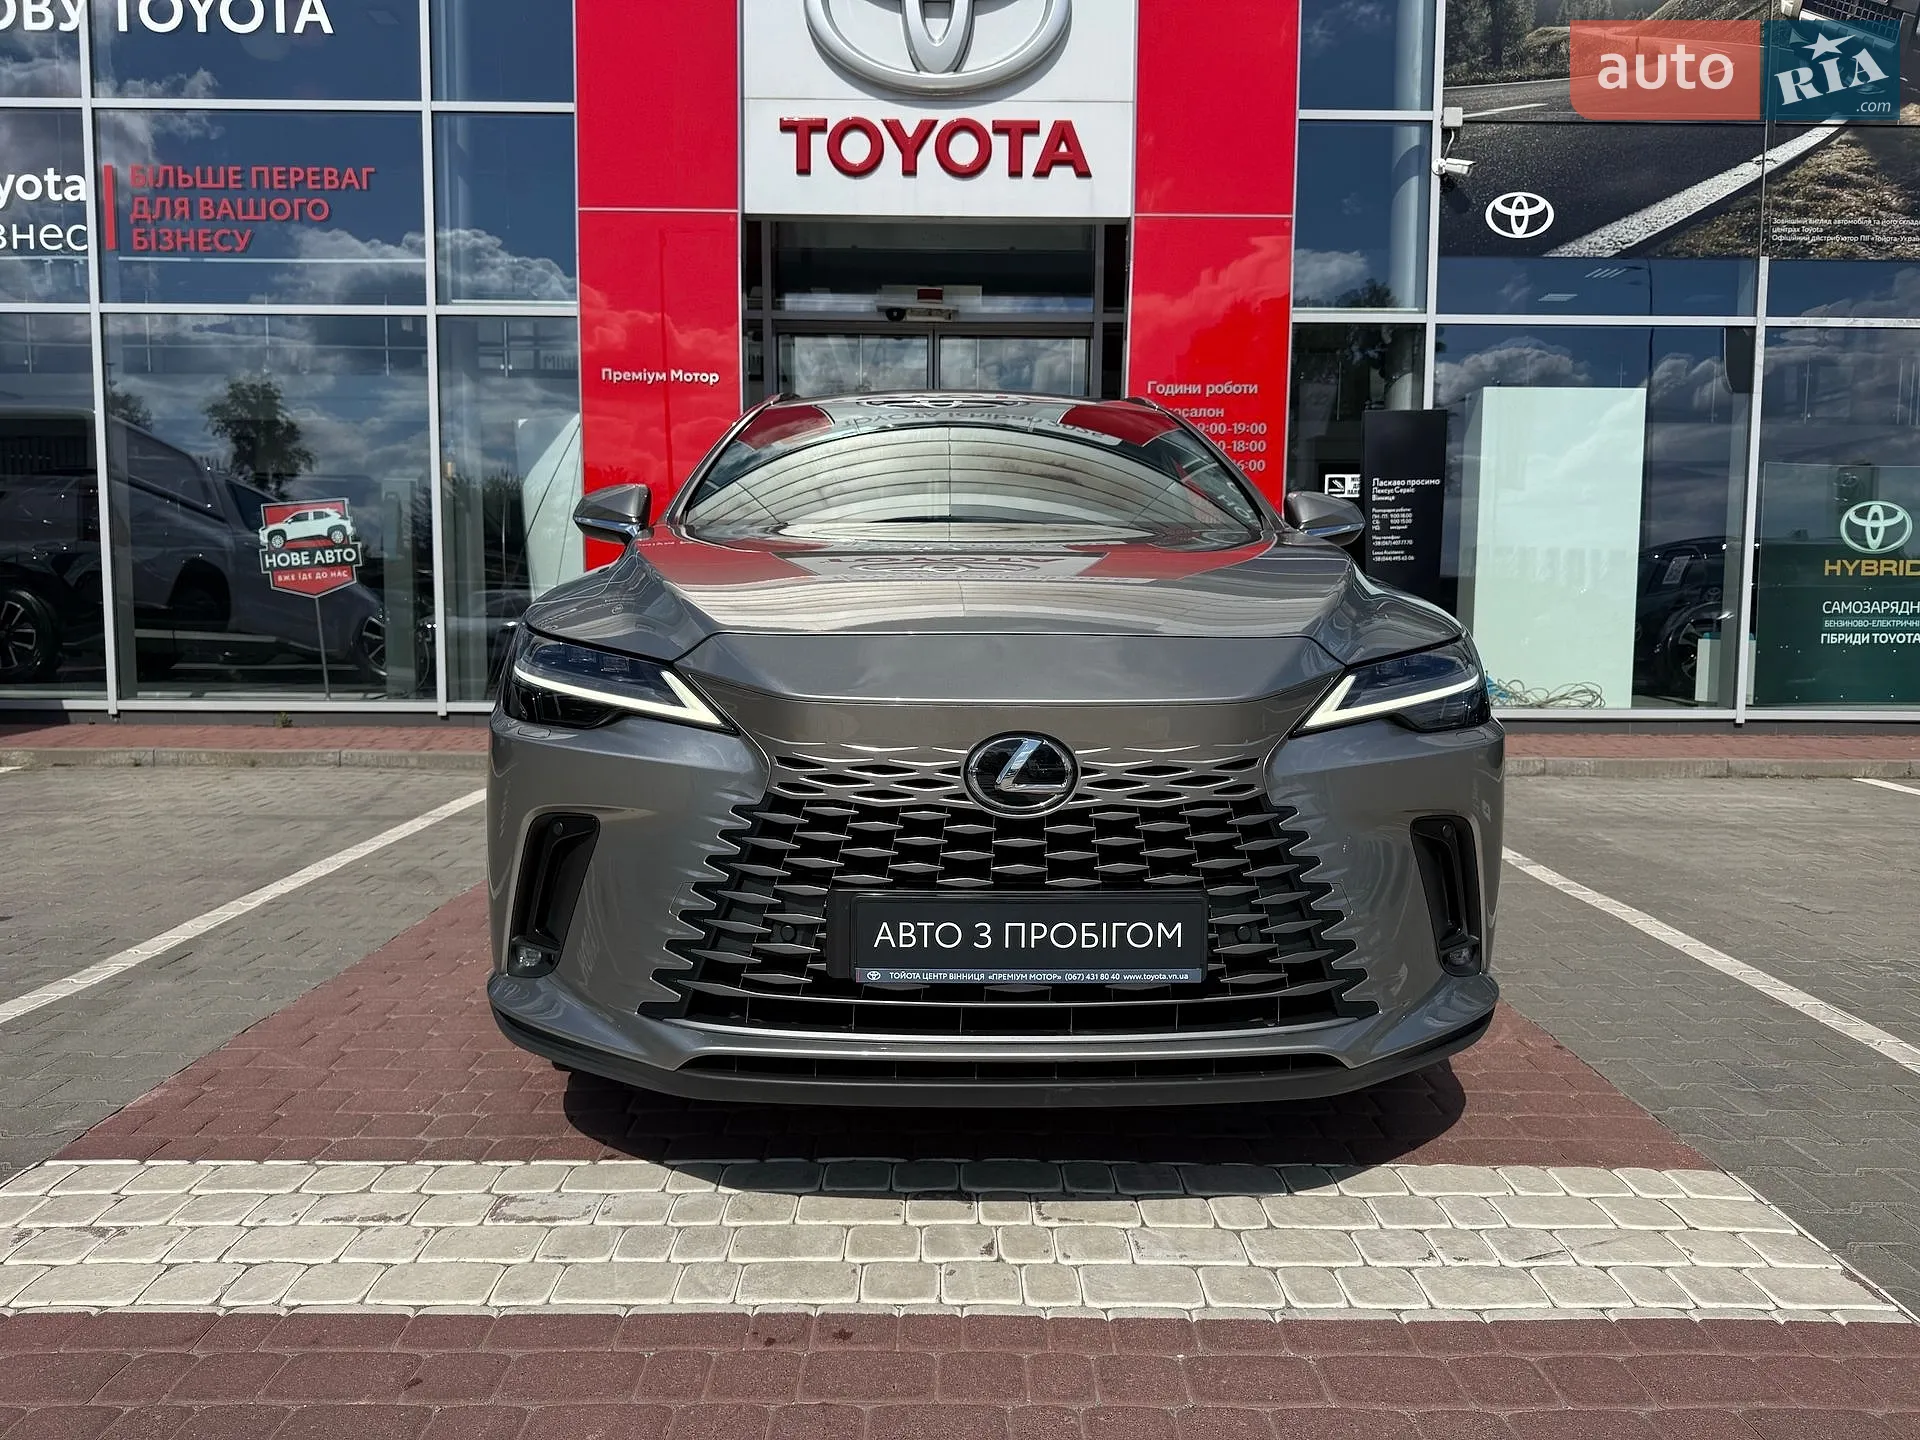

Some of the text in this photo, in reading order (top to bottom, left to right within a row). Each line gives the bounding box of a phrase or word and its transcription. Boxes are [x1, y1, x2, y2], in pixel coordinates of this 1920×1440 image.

[780, 117, 1092, 178] TOYOTA
[130, 164, 375, 190] БІЛЬШЕ ПЕРЕВАГ
[130, 196, 329, 221] ДЛЯ ВАШОГО
[132, 228, 252, 252] БІЗНЕСУ
[601, 368, 720, 386] Преміум Мотор
[1147, 381, 1258, 397] Години роботи
[1372, 478, 1441, 487] Ласкаво просимо
[265, 548, 357, 568] НОВЕ АВТО
[1824, 560, 1920, 576] HYBRID
[1821, 633, 1920, 645] ГІБРИДИ TOYOTA
[874, 921, 1183, 949] АВТО З ПРОБІГОМ
[889, 971, 921, 980] ТОЙОТА
[922, 972, 948, 981] ЦЕНТР
[949, 972, 985, 981] ВІННИЦЯ
[1064, 973, 1085, 981] (067)
[1085, 973, 1098, 981] 431
[1123, 973, 1189, 982] www.toyota.vn.ua
